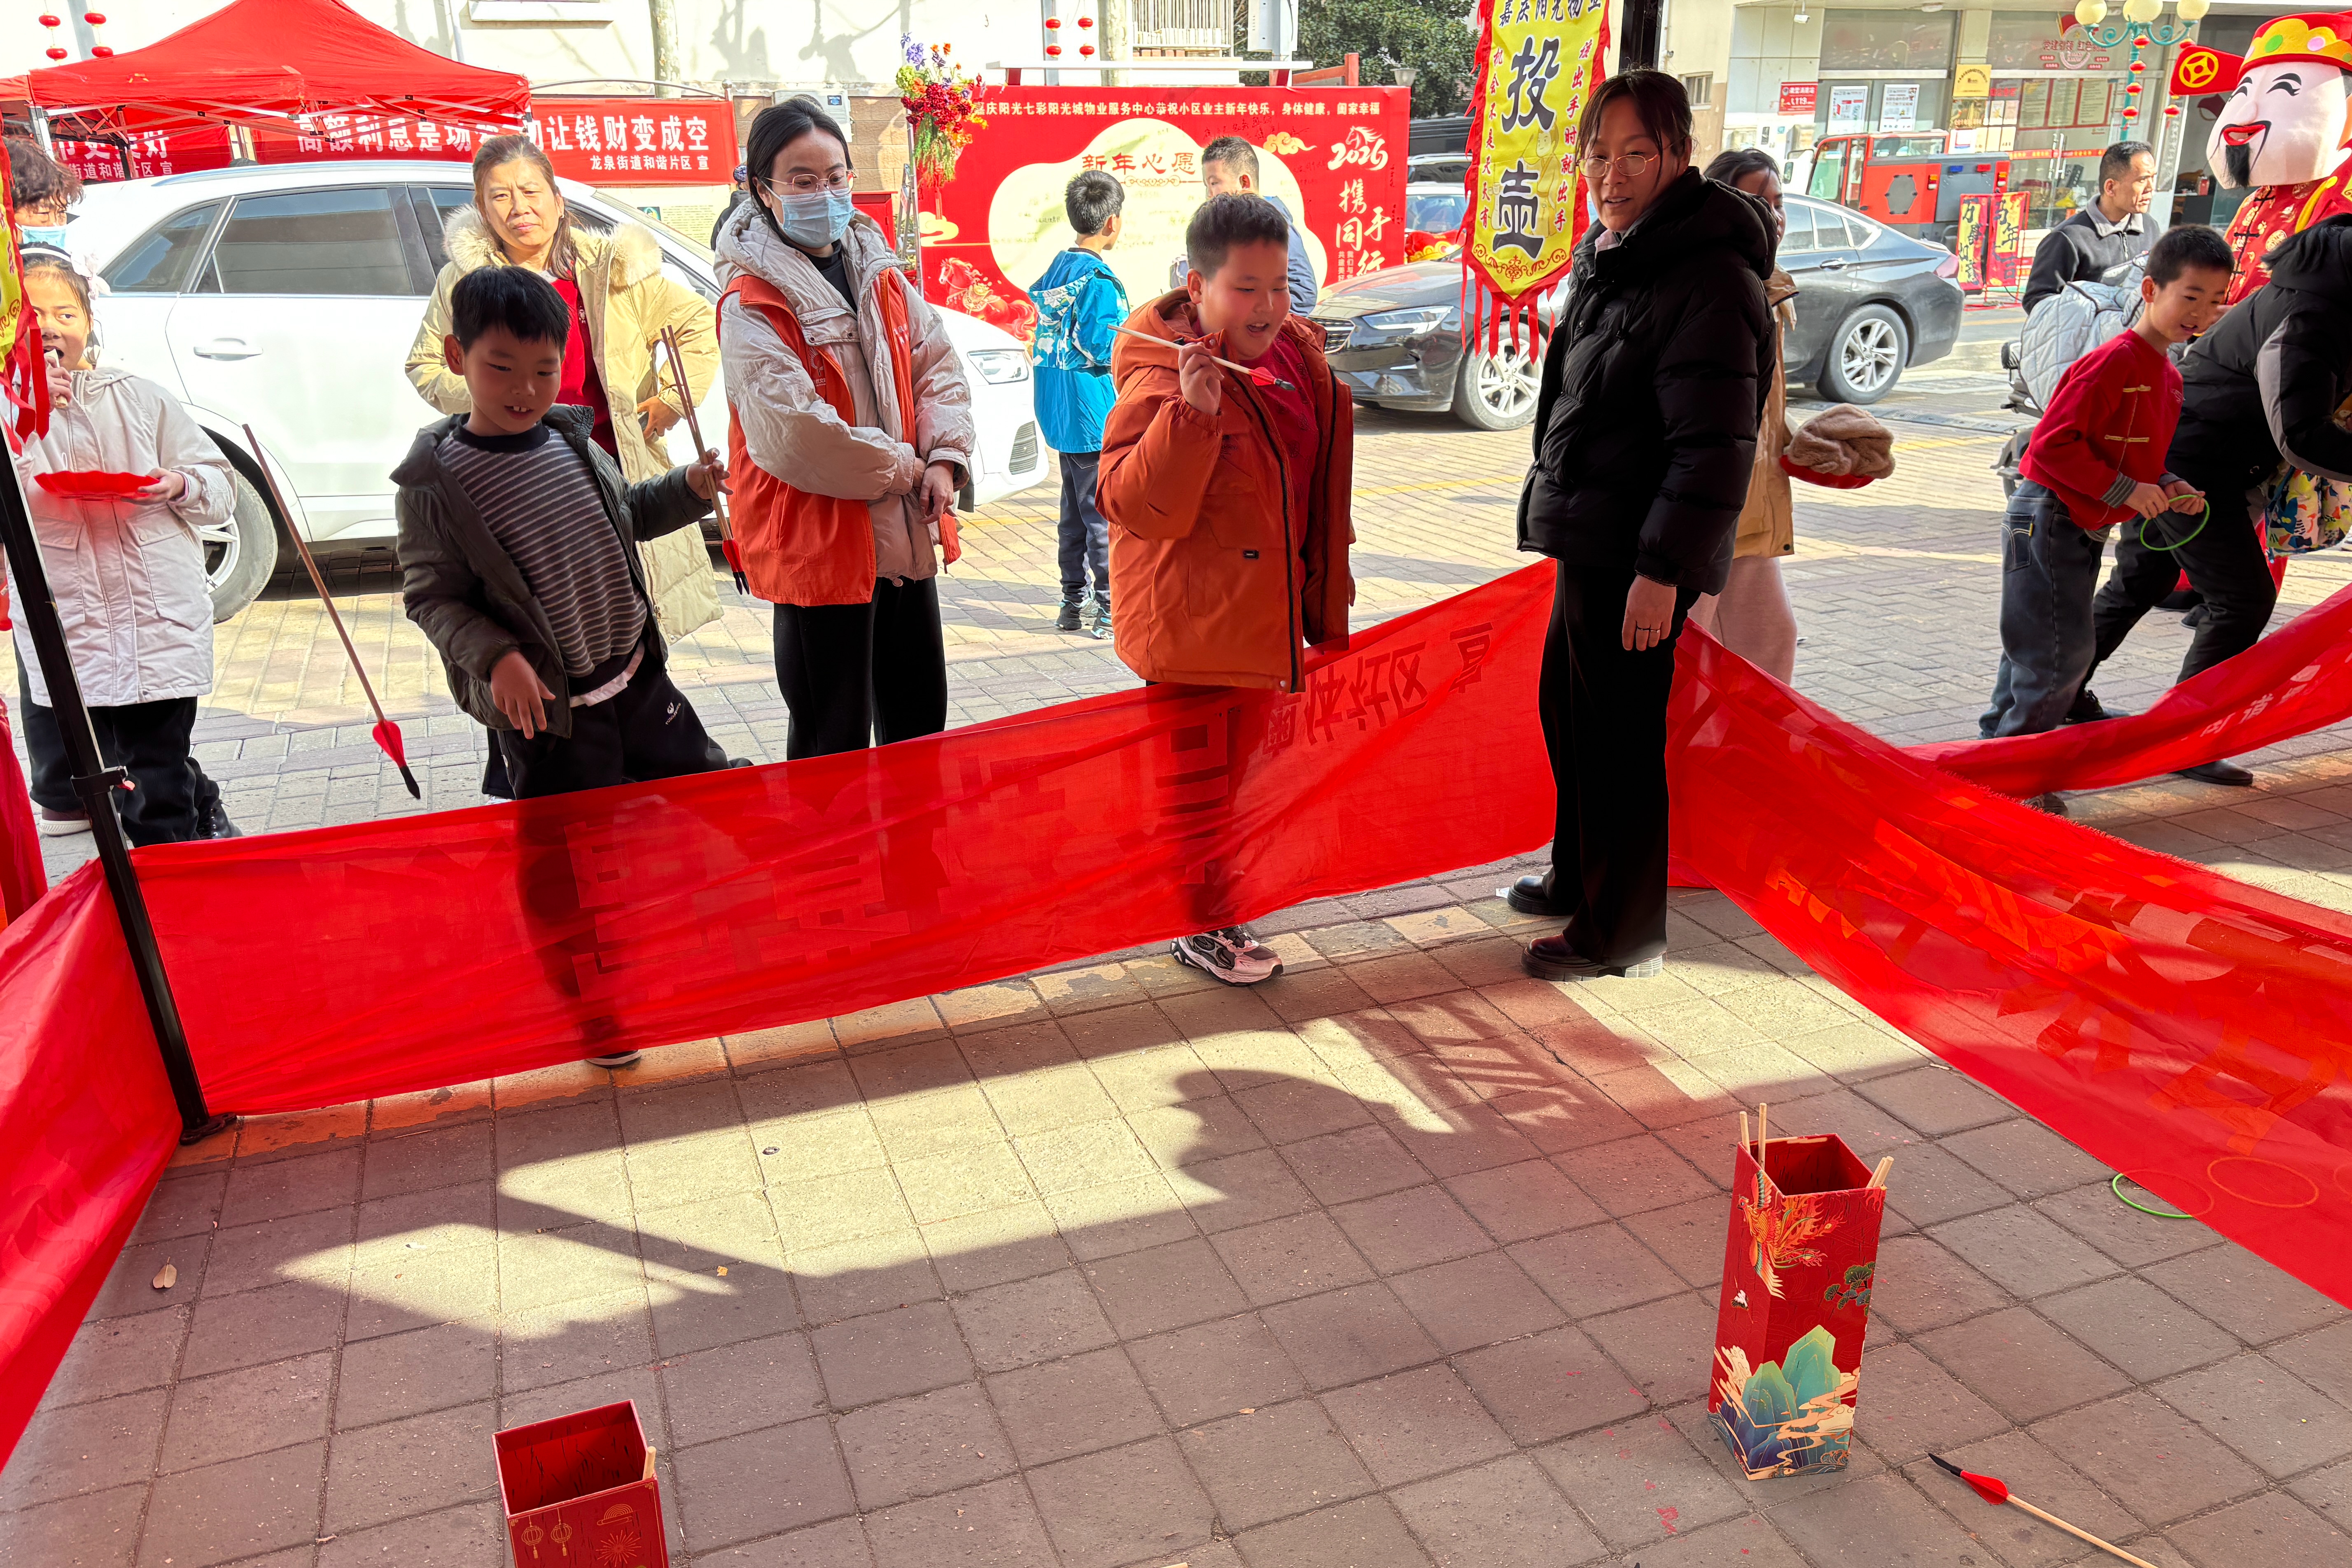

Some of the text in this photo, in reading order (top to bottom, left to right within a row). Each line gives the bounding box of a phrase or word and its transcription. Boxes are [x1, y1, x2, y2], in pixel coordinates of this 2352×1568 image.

[1480, 47, 1503, 229] 机会不是天天有
[1493, 37, 1560, 259] 投壶
[590, 155, 709, 170] 龙泉街道和谐片区 宣
[1082, 152, 1195, 175] 新年心愿
[1328, 138, 1388, 170] 2026
[160, 161, 173, 175] 宣
